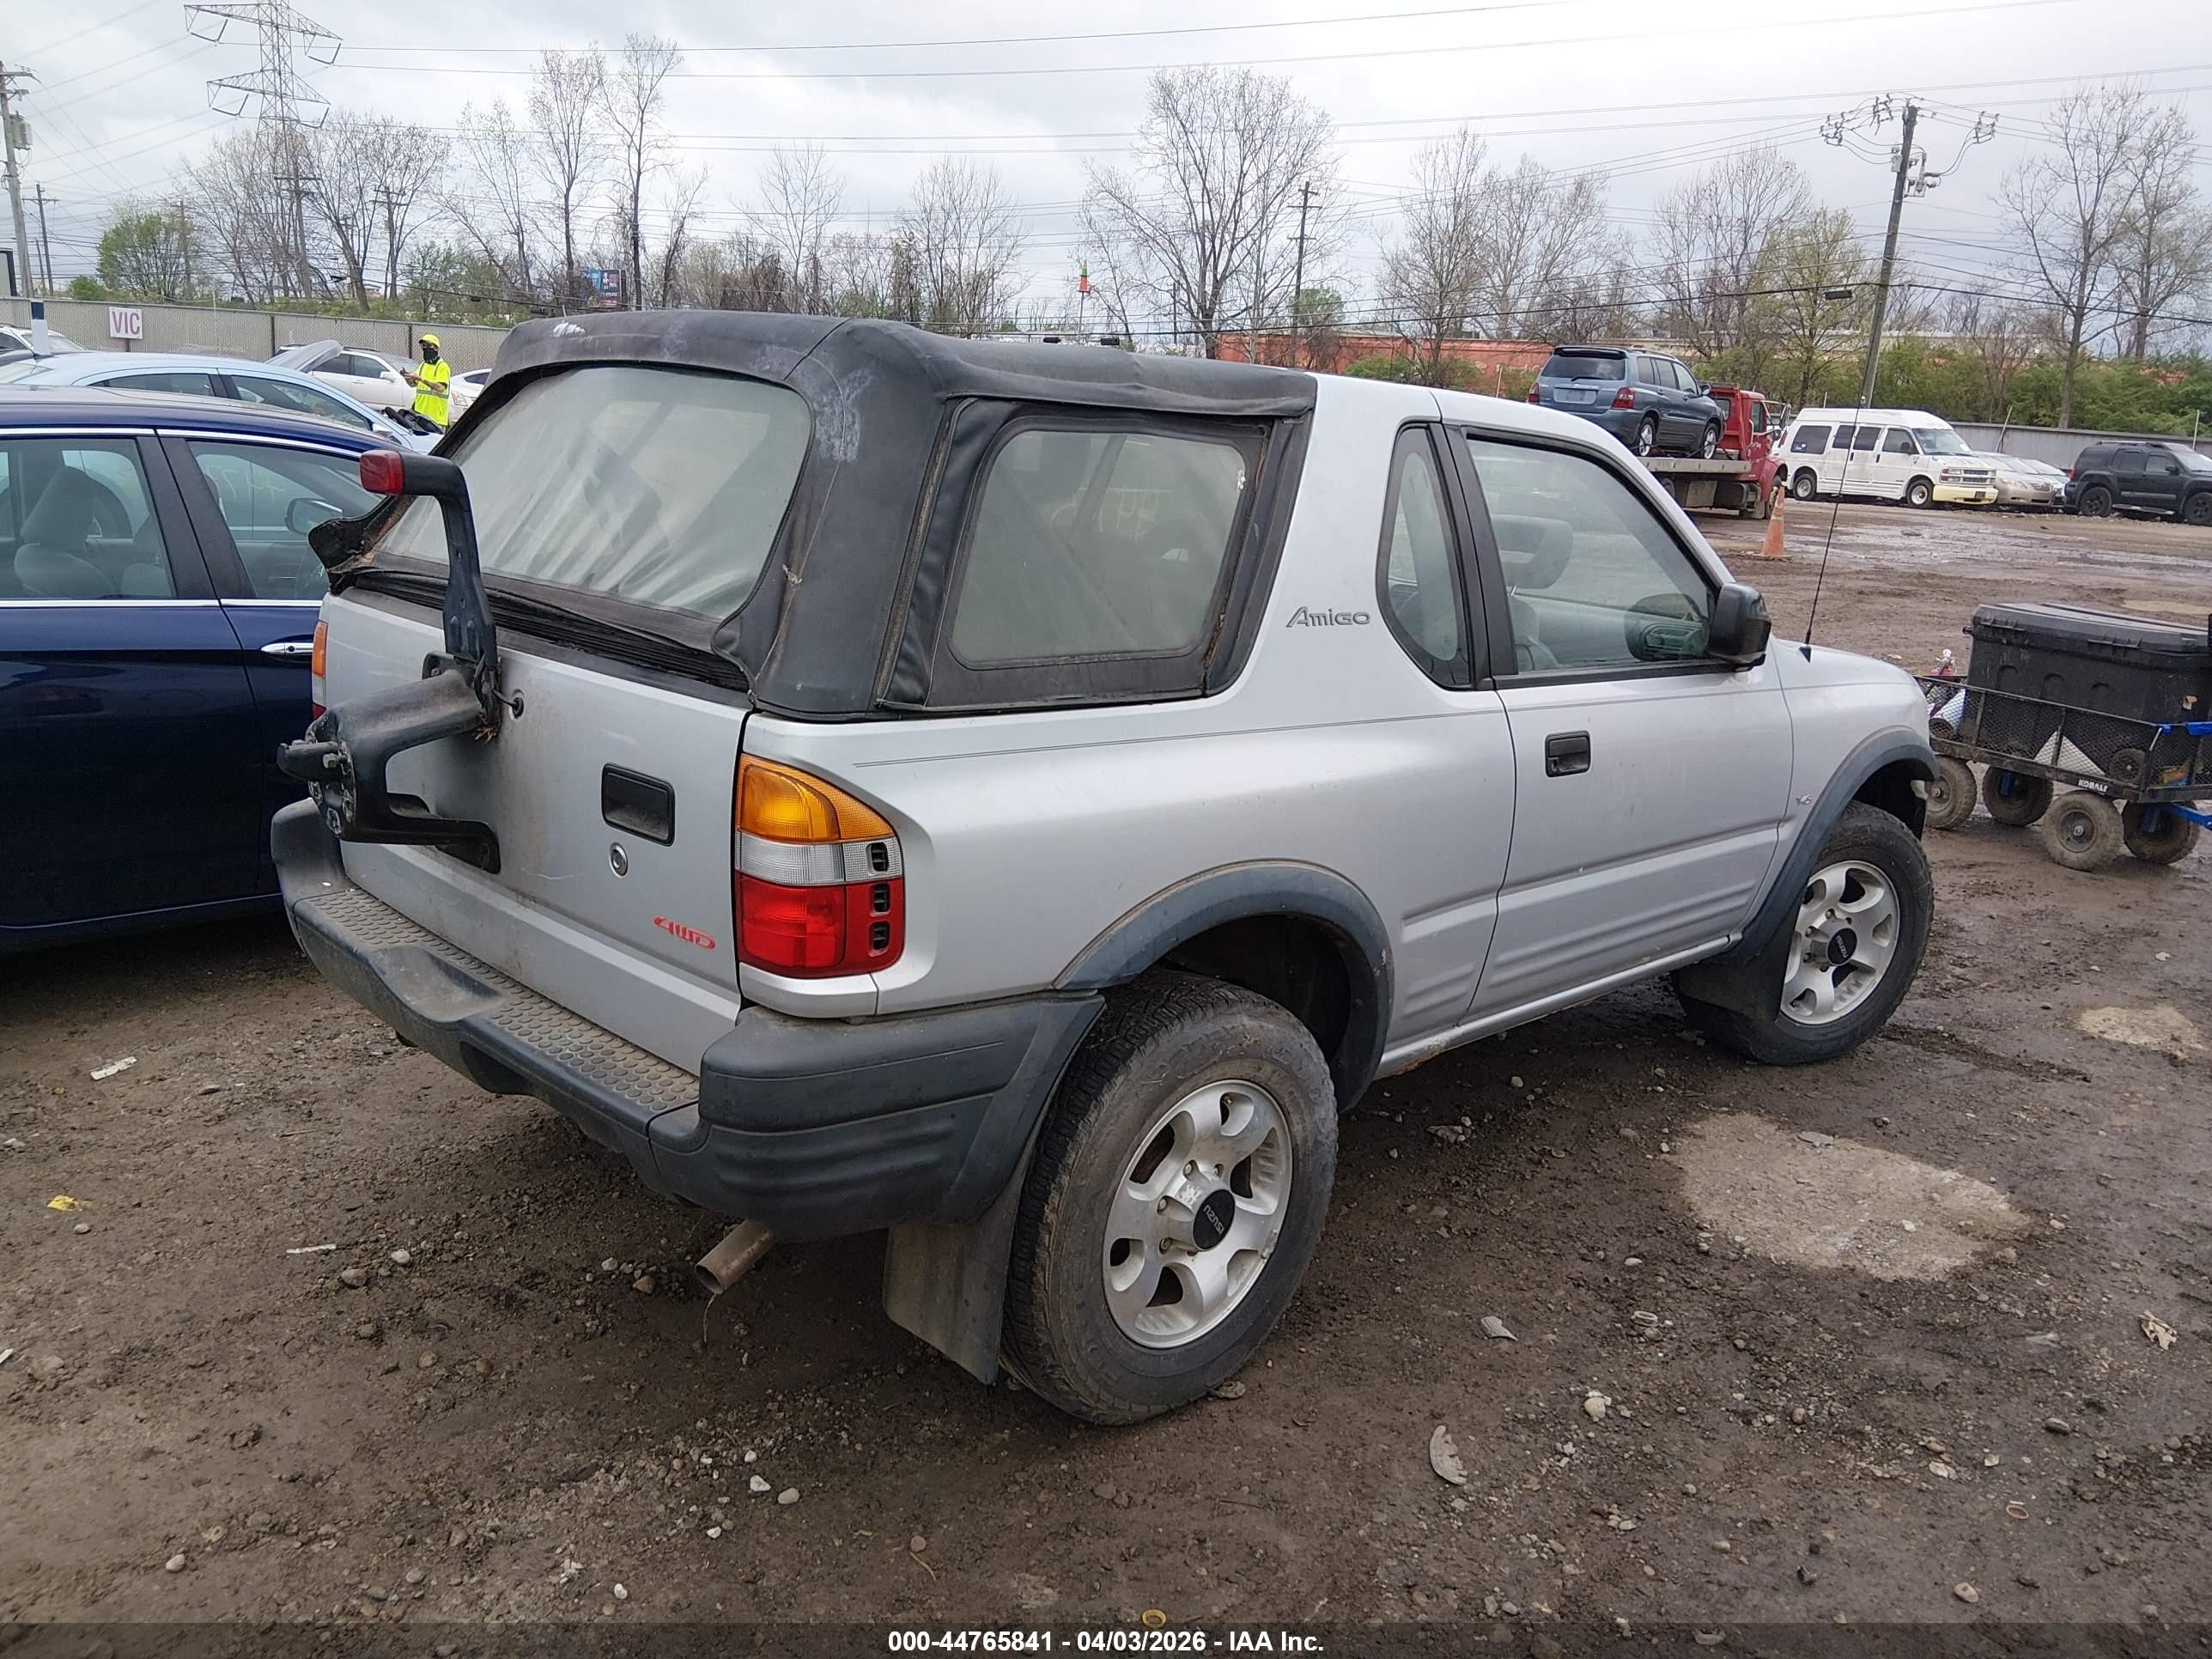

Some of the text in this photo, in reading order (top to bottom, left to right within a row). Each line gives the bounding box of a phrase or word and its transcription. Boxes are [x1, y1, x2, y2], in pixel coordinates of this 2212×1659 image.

[112, 311, 140, 335] VIC
[1285, 605, 1370, 628] Amigo
[653, 915, 716, 949] 4WD
[1835, 934, 1849, 959] ISUZU
[1202, 1204, 1225, 1236] ISUZU
